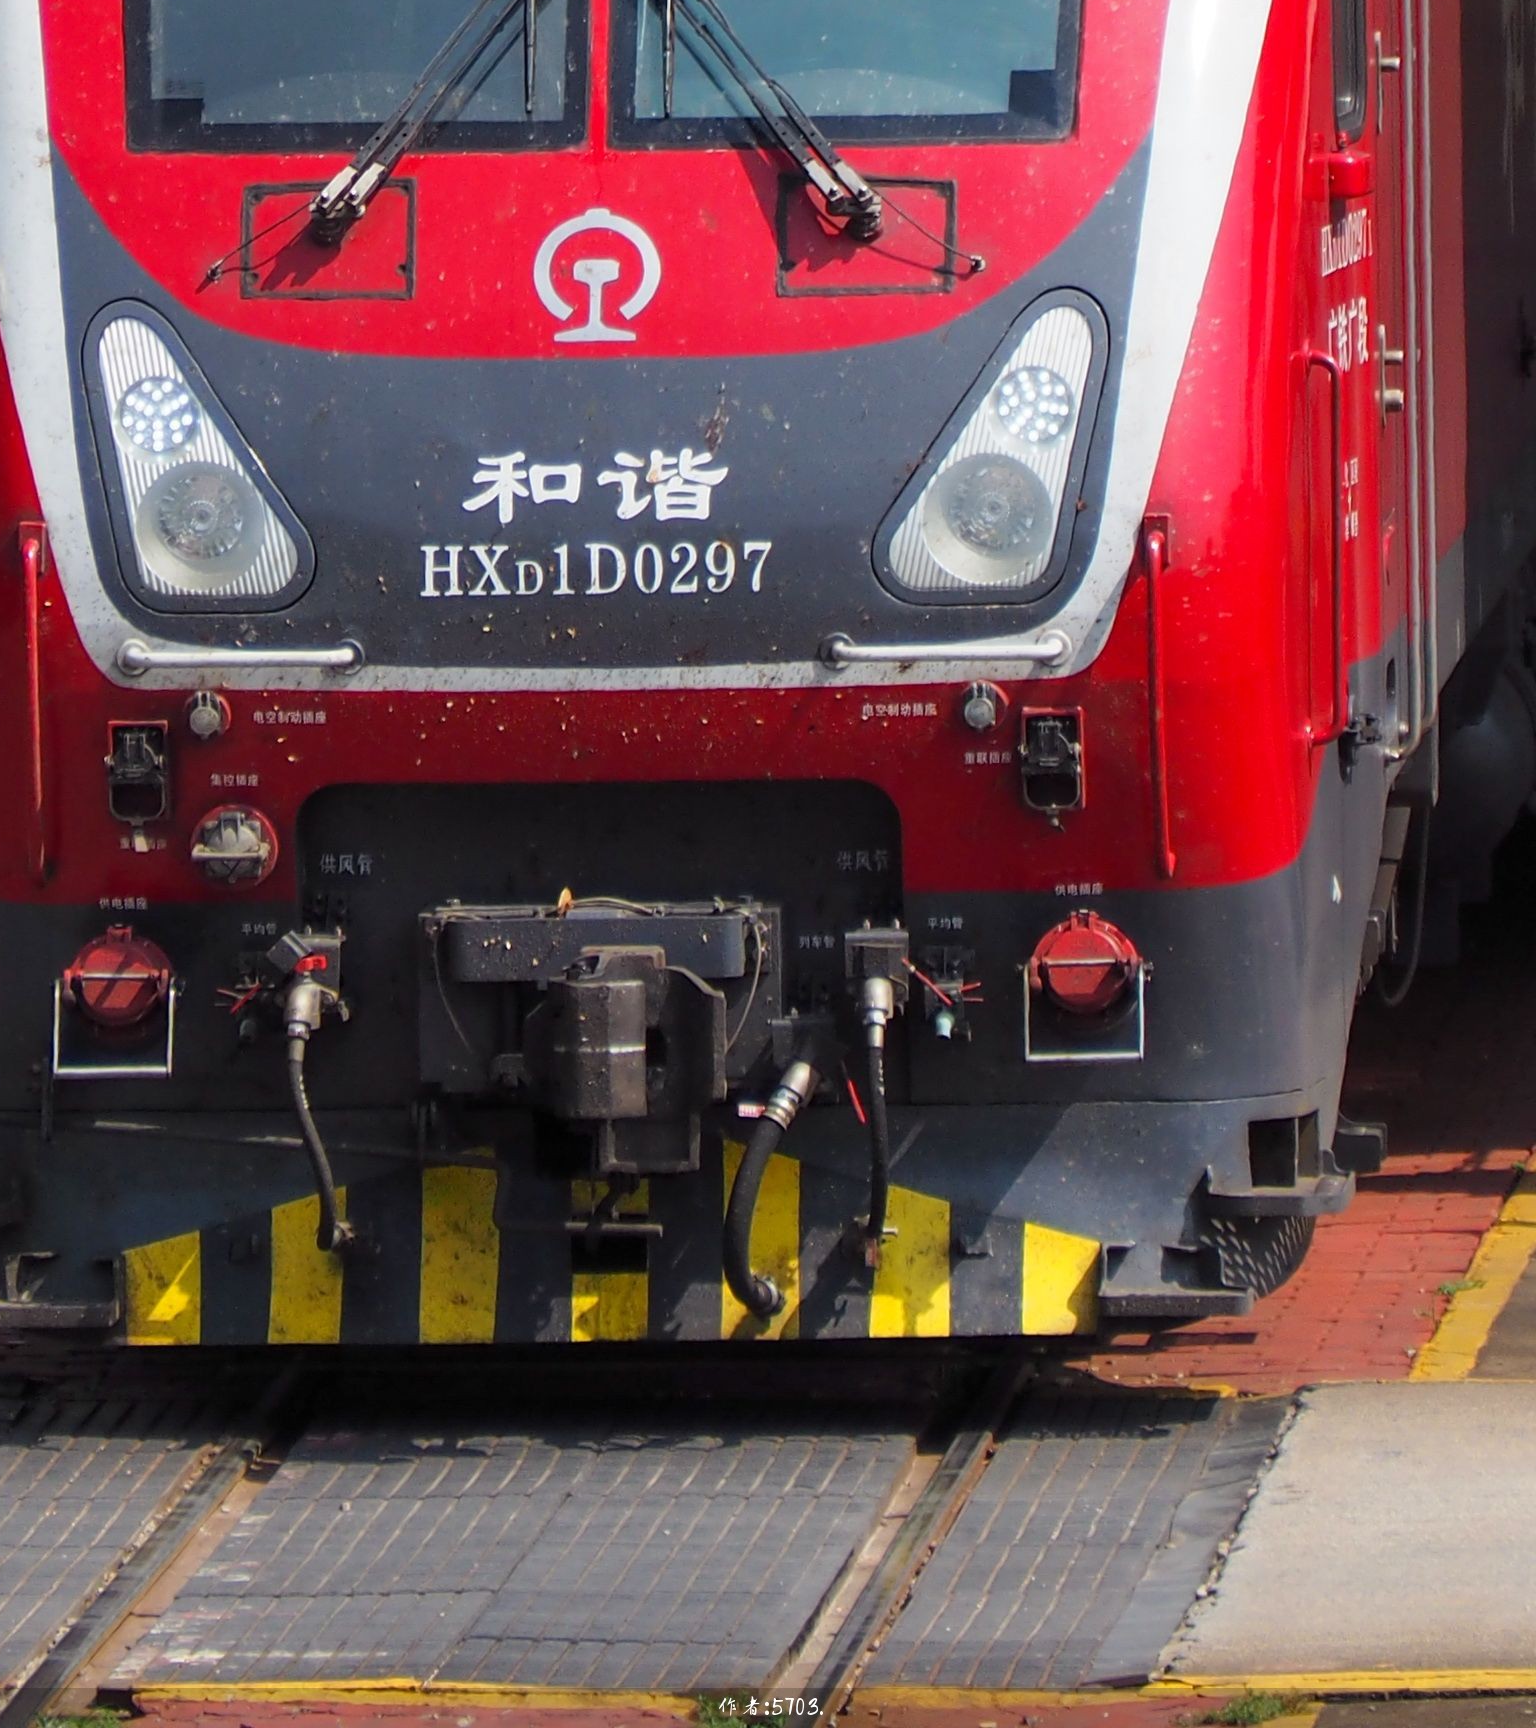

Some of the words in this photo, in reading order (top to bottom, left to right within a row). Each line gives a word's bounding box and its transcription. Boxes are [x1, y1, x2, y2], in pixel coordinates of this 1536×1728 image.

[462, 448, 728, 524] 和谐
[420, 541, 772, 597] HXD1D0297
[862, 702, 937, 717] 电空制动插座
[253, 710, 327, 725] 电空制动插座
[1054, 882, 1104, 896] 供电插座
[99, 897, 148, 911] 供电插座
[241, 923, 277, 936] 平均管
[927, 916, 963, 930] 平均管
